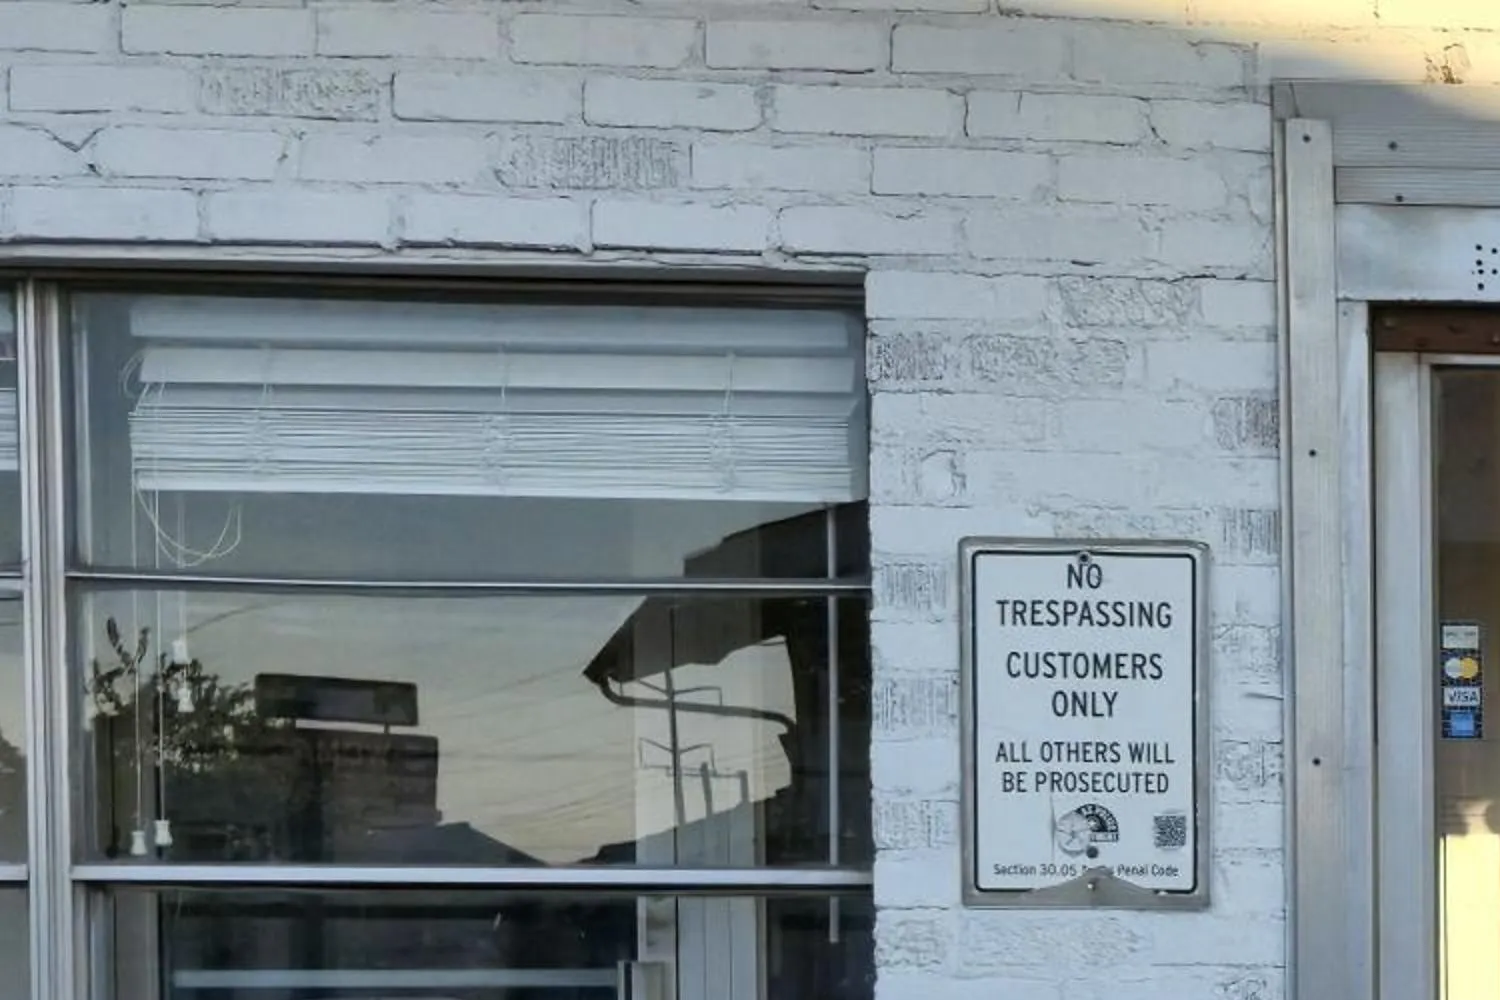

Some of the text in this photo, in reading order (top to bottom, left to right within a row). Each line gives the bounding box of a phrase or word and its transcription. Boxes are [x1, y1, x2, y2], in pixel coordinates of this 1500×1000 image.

[1067, 563, 1102, 589] NO
[996, 600, 1173, 628] TRESPASSING
[1006, 652, 1164, 680] CUSTOMERS
[1051, 690, 1119, 718] ONLY
[995, 742, 1176, 765] ALL OTHERS WILL
[1002, 771, 1170, 794] BE PROSECUTED
[993, 863, 1037, 876] Section
[1039, 863, 1078, 877] 30.05
[1117, 863, 1148, 877] Penal
[1150, 863, 1180, 877] Code
